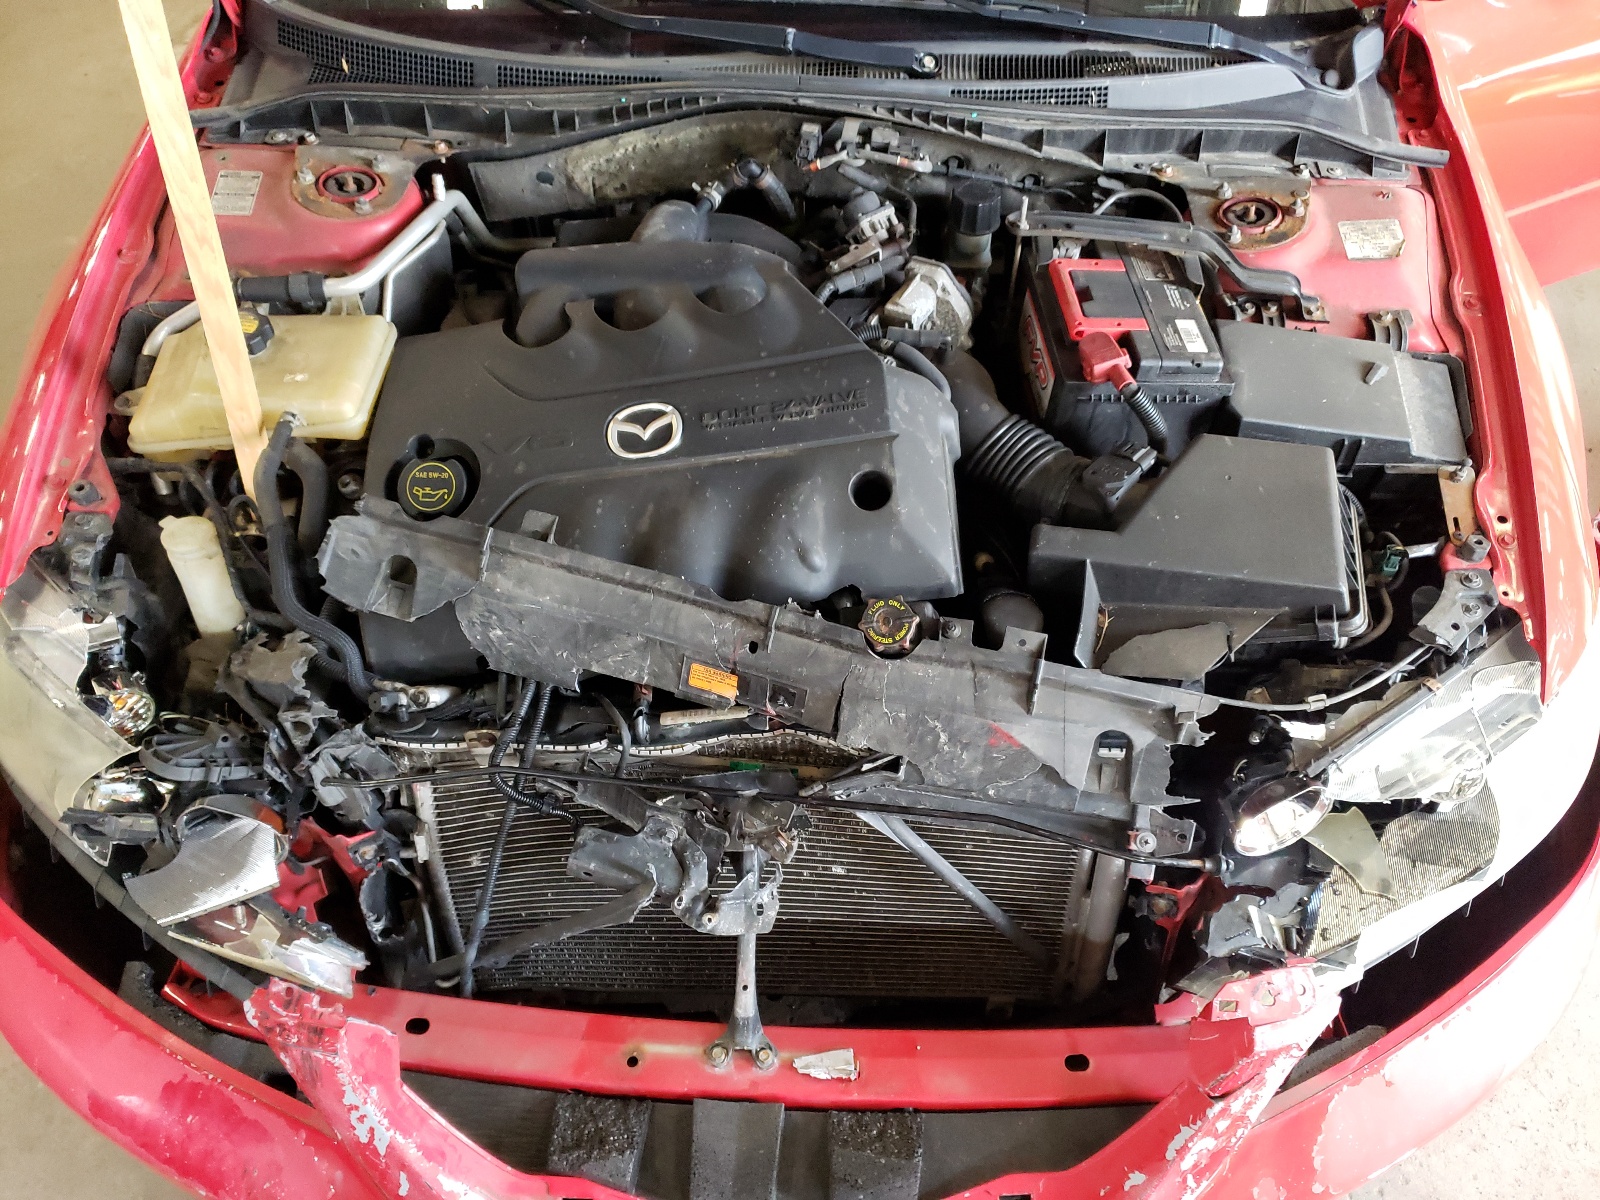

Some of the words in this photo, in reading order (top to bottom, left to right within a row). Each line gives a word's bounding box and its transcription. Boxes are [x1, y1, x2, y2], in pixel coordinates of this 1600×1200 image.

[701, 404, 771, 424] DOHC
[819, 401, 869, 415] TIMING
[415, 471, 428, 479] SAE
[428, 471, 449, 479] 5W-20
[868, 601, 884, 614] FLUID
[888, 600, 906, 610] ONLY
[868, 627, 893, 643] STEERING
[894, 623, 909, 640] POWER
